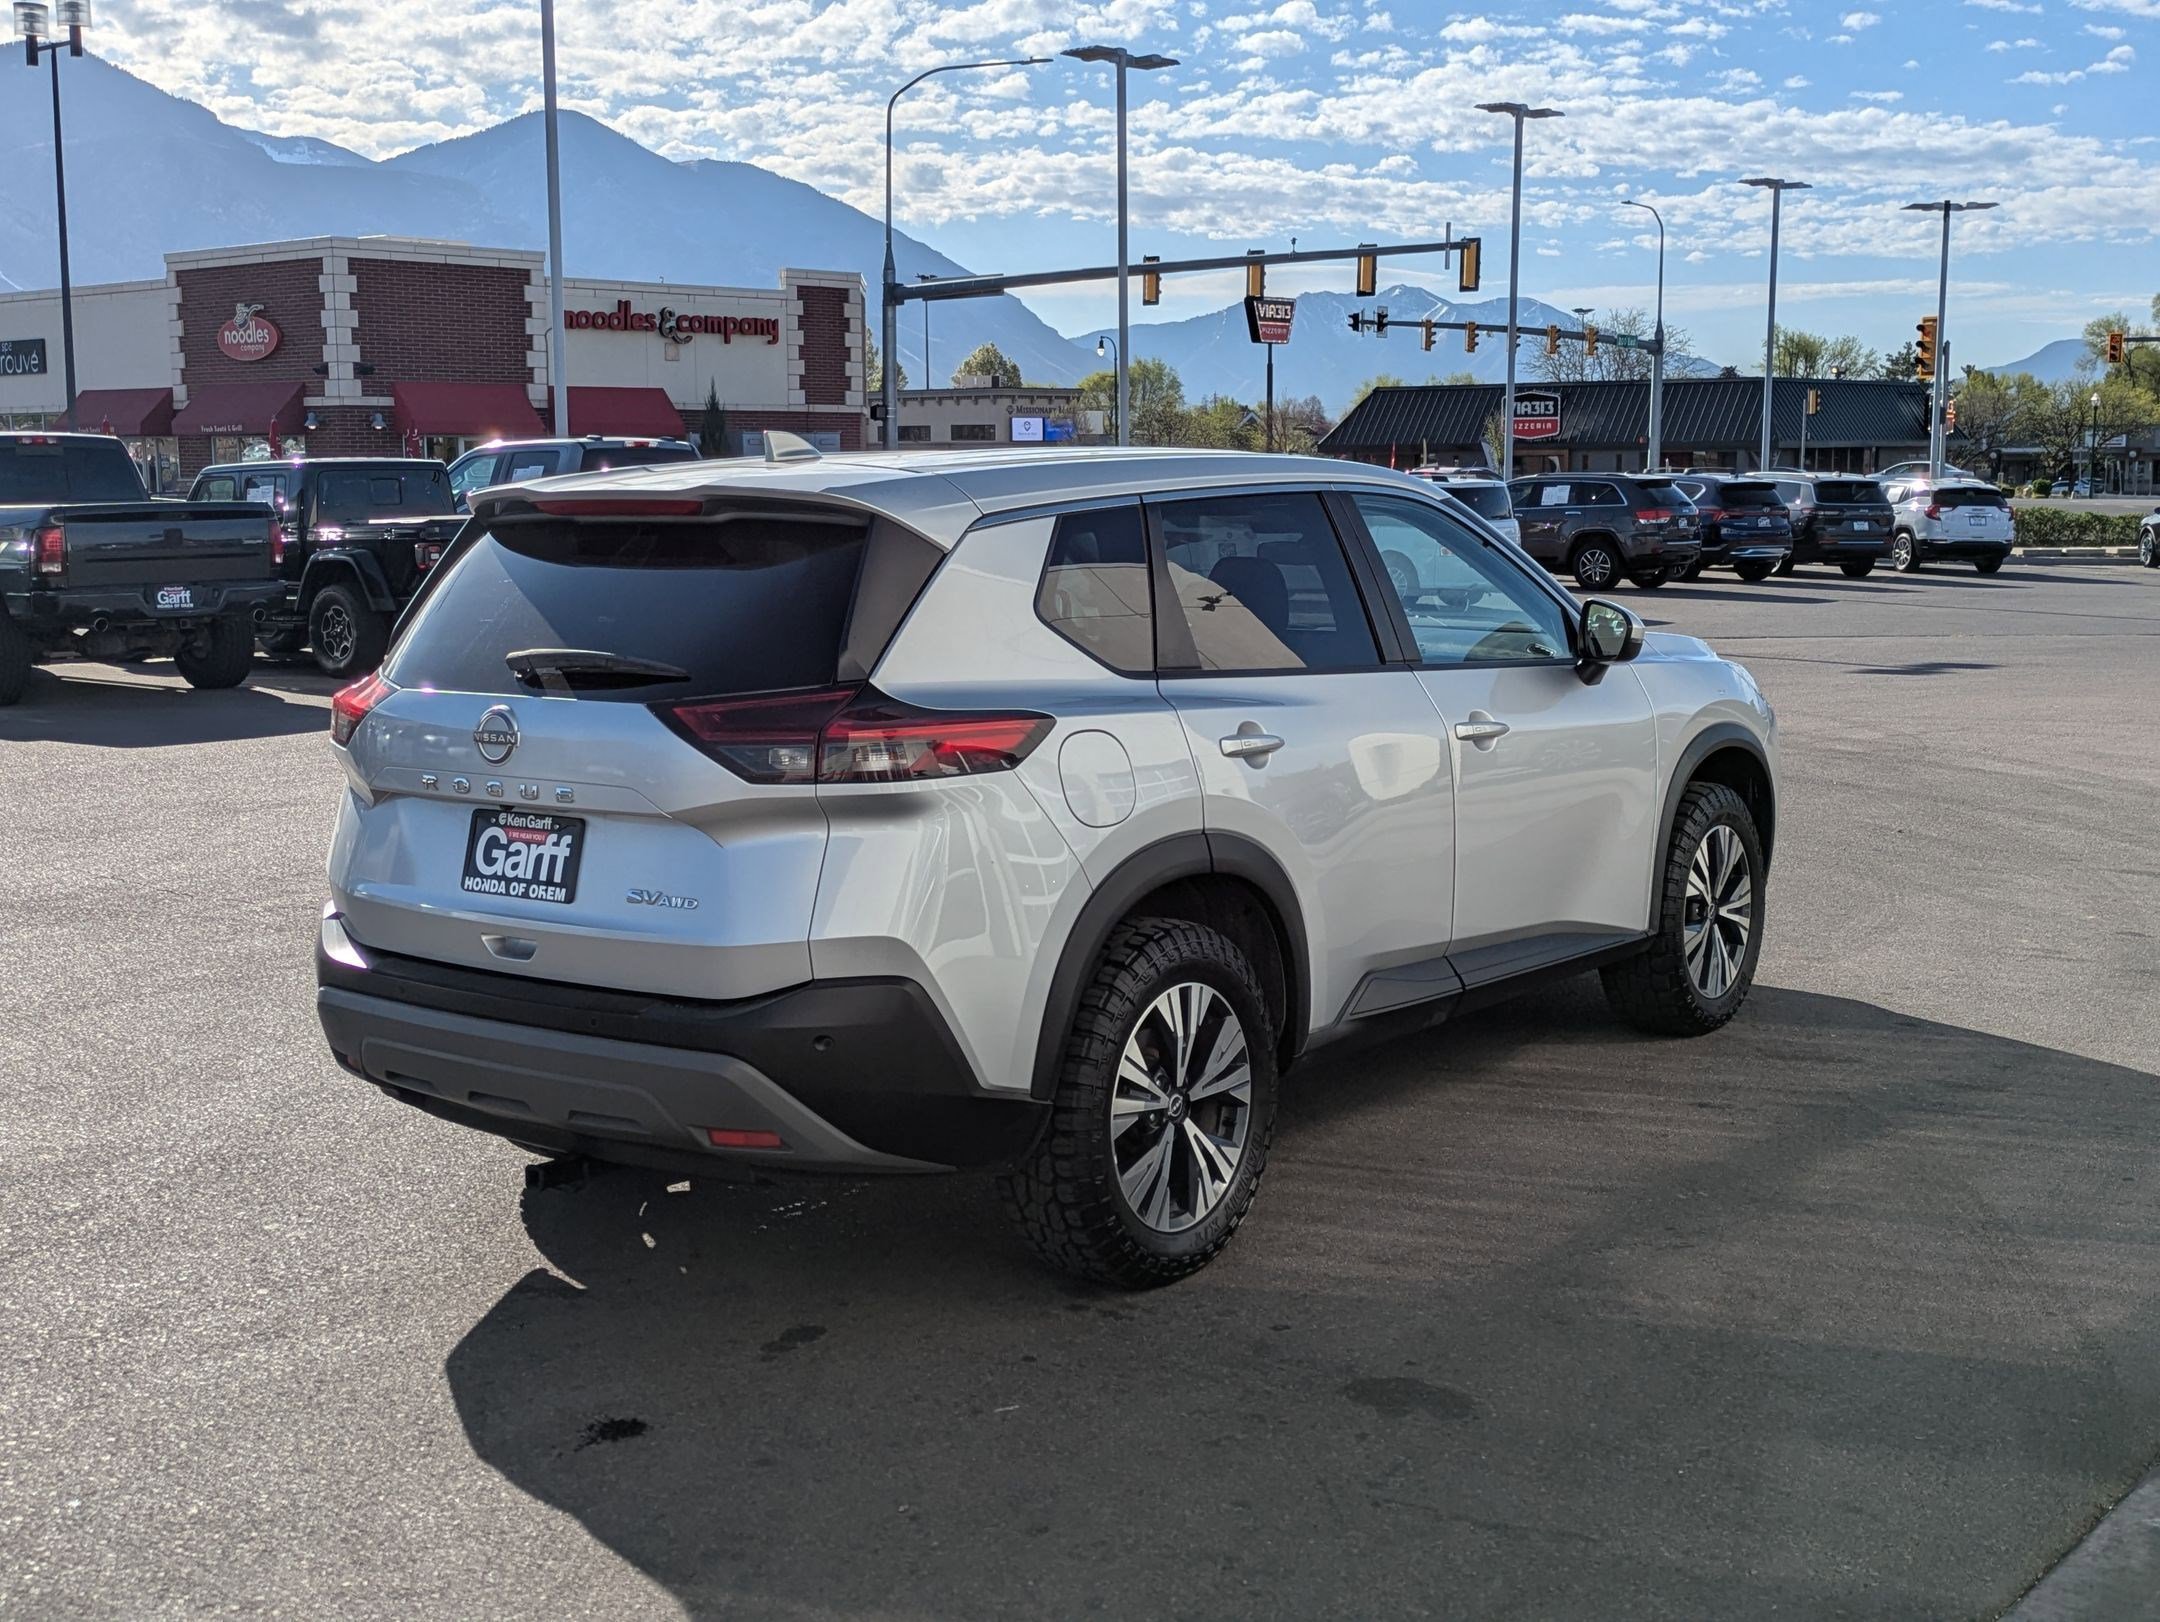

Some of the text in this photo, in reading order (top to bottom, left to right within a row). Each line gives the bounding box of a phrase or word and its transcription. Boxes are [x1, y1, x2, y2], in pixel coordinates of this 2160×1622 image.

[564, 300, 656, 332] noodles
[676, 315, 779, 344] company
[224, 320, 269, 345] noodles
[240, 344, 265, 354] company
[0, 349, 39, 374] rouvé
[1514, 401, 1554, 415] IA313
[1514, 422, 1552, 430] IZZERIA
[157, 590, 191, 604] Garff
[473, 732, 516, 744] NISSAN
[421, 773, 575, 803] ROGUE
[527, 815, 553, 830] Garff
[475, 826, 573, 884] Garff
[463, 876, 567, 902] HONDA OF OREM
